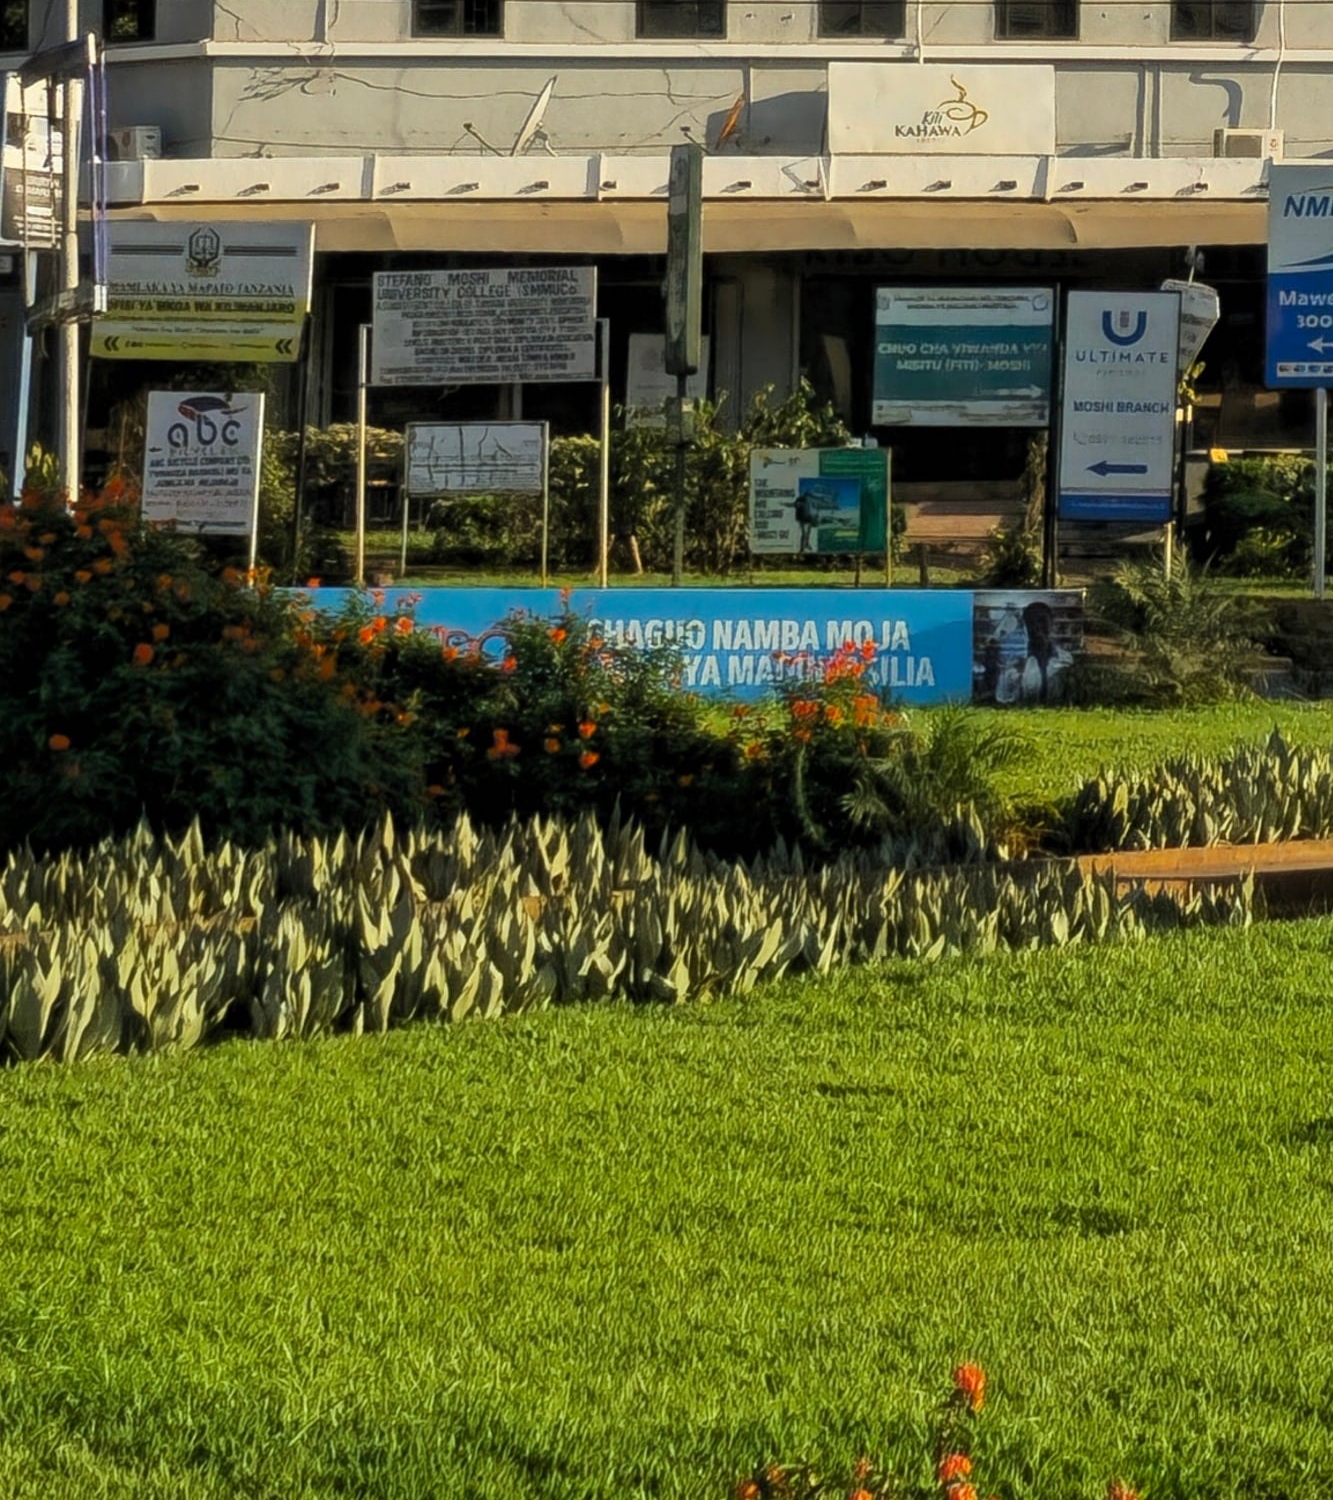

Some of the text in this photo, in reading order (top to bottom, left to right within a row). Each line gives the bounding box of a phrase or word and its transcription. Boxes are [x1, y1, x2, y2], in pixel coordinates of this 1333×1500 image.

[895, 125, 962, 137] KAHAWA
[377, 270, 579, 287] STEFANO MOSHI MEMORIAL
[238, 283, 295, 296] TANZANIA
[377, 286, 450, 300] UNIVERSITY
[457, 284, 511, 299] COLLEGE
[878, 343, 917, 355] CHUO
[919, 343, 949, 355] CHA
[1075, 350, 1169, 364] ULTIMATE
[987, 359, 1031, 371] MOSHI
[1073, 400, 1170, 414] MOSHI BRANCH
[167, 414, 242, 447] abc
[586, 618, 911, 651] CHAGUO NAMBA MOJA
[684, 654, 722, 686] YA
